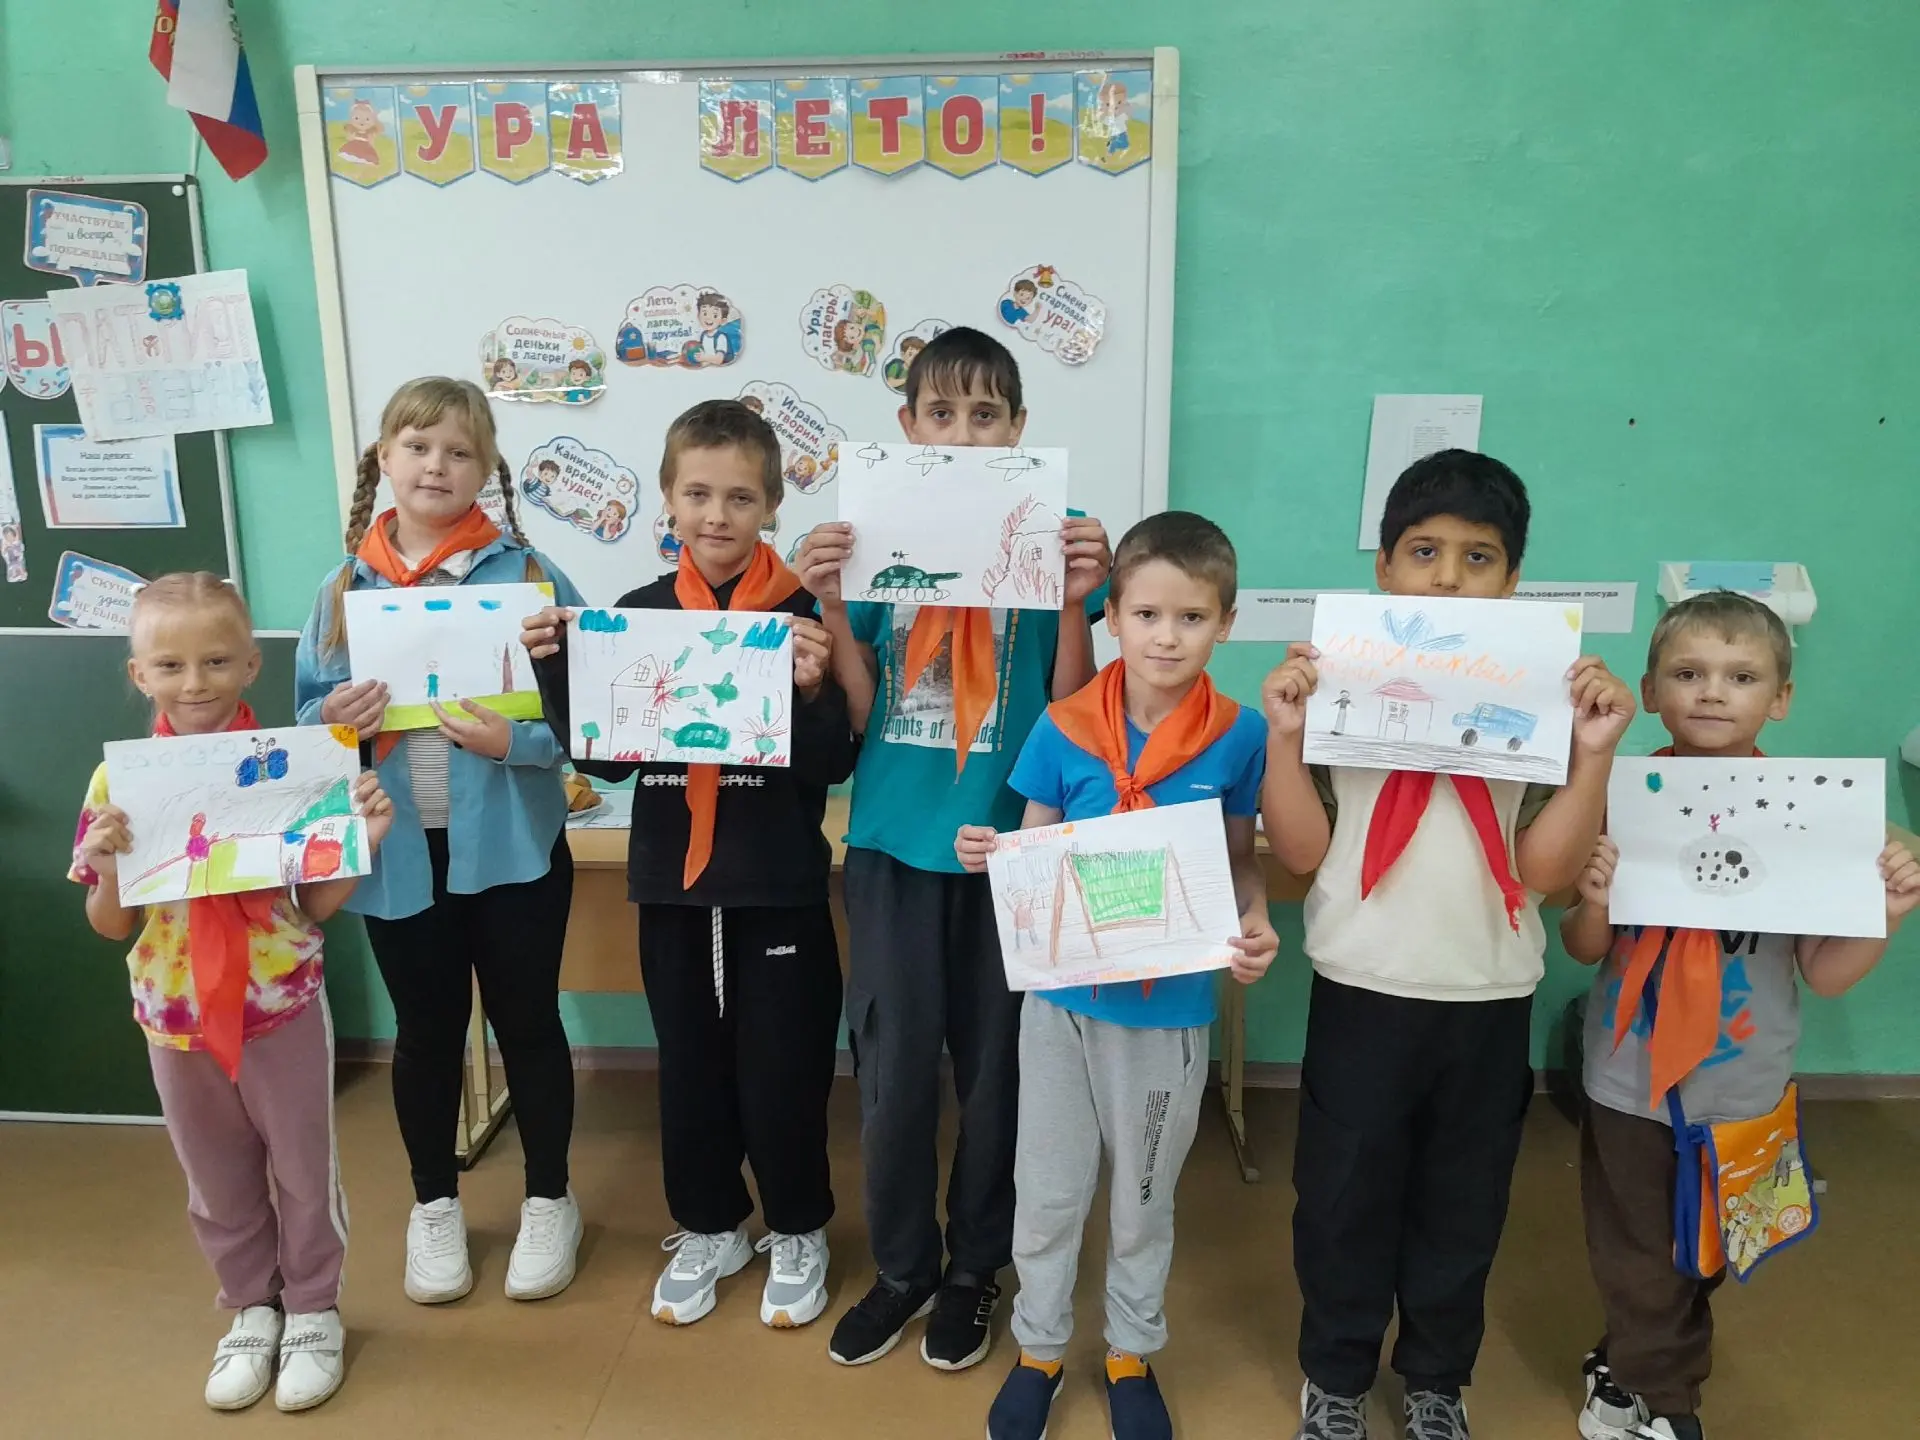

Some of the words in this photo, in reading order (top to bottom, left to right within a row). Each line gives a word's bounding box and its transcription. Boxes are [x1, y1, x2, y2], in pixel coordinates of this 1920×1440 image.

[413, 101, 610, 163] УРА
[711, 93, 1046, 159] ЛЕТО!
[1056, 285, 1088, 312] Смена
[506, 324, 567, 340] Солнечные
[806, 306, 824, 336] Ура,
[822, 292, 840, 350] лагерь!
[1042, 310, 1076, 333] ура!
[514, 338, 560, 351] деньки
[511, 351, 519, 359] в
[523, 351, 566, 365] лагере!
[778, 411, 820, 448] творим,
[782, 396, 826, 438] Играем,
[764, 416, 823, 460] побеждаем!
[554, 443, 609, 481] Каникулы
[561, 475, 604, 504] чудес!
[565, 464, 603, 490] время
[91, 576, 131, 596] СКУЧН
[1584, 591, 1619, 599] посуда
[1293, 597, 1315, 605] посу
[92, 606, 130, 626] БЫВА
[930, 719, 946, 739] of
[641, 774, 688, 787] STRE
[1158, 1090, 1171, 1122] MOVING
